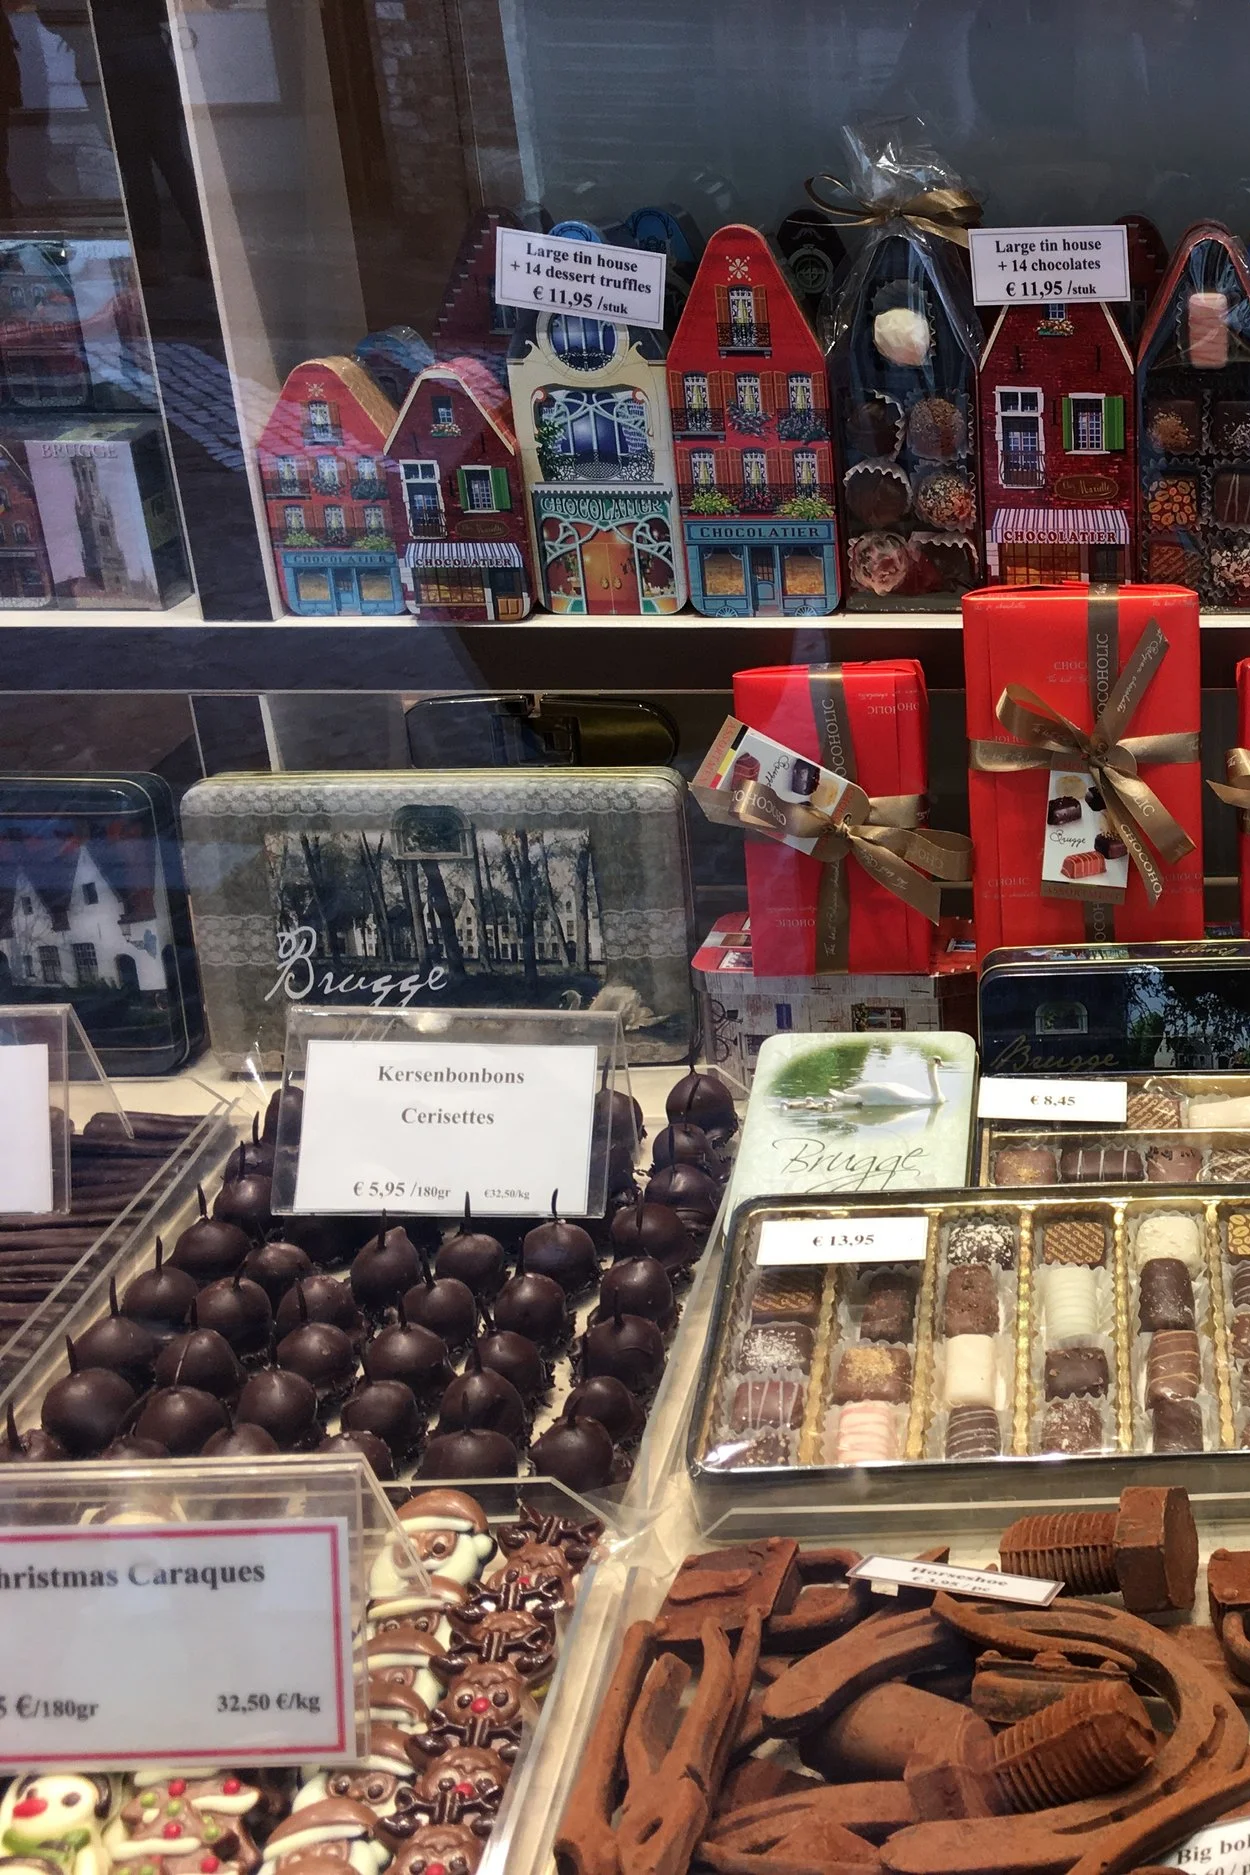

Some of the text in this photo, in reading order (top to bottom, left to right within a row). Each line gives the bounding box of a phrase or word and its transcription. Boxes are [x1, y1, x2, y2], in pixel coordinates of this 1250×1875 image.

[995, 238, 1101, 255] Large tin house
[526, 243, 638, 272] Large tin house
[998, 257, 1101, 272] + 14 chocolates
[510, 261, 652, 294] + 14 dessert truffles
[1006, 280, 1097, 299] € 11,95 /stuk
[533, 286, 628, 314] € 11,95 /stuk
[42, 443, 117, 459] BRUGGE
[541, 497, 662, 521] CHOCOLATIER
[700, 526, 820, 538] CHOCOLATIER
[1004, 530, 1117, 543] CHOCOLATIER
[294, 555, 388, 564] CHOCOLATIER
[415, 558, 512, 567] CHOCOLATIER
[1050, 829, 1086, 848] Brugge
[265, 926, 448, 1008] Brugge
[990, 1035, 1119, 1071] Brugge
[378, 1066, 525, 1084] Kersenbonbons
[1030, 1095, 1076, 1107] € 8,45
[401, 1107, 495, 1125] Cerisettes
[772, 1137, 930, 1193] Brugge
[353, 1181, 530, 1200] € 5,95 /180gr €32,50/kg
[813, 1234, 875, 1248] € 13,95
[128, 1562, 265, 1590] Caraques
[912, 1566, 1008, 1587] Horseshoe
[16, 1695, 99, 1722] €/180gr
[218, 1694, 270, 1714] 32,50
[277, 1693, 321, 1715] €/kg
[1177, 1847, 1212, 1865] Big
